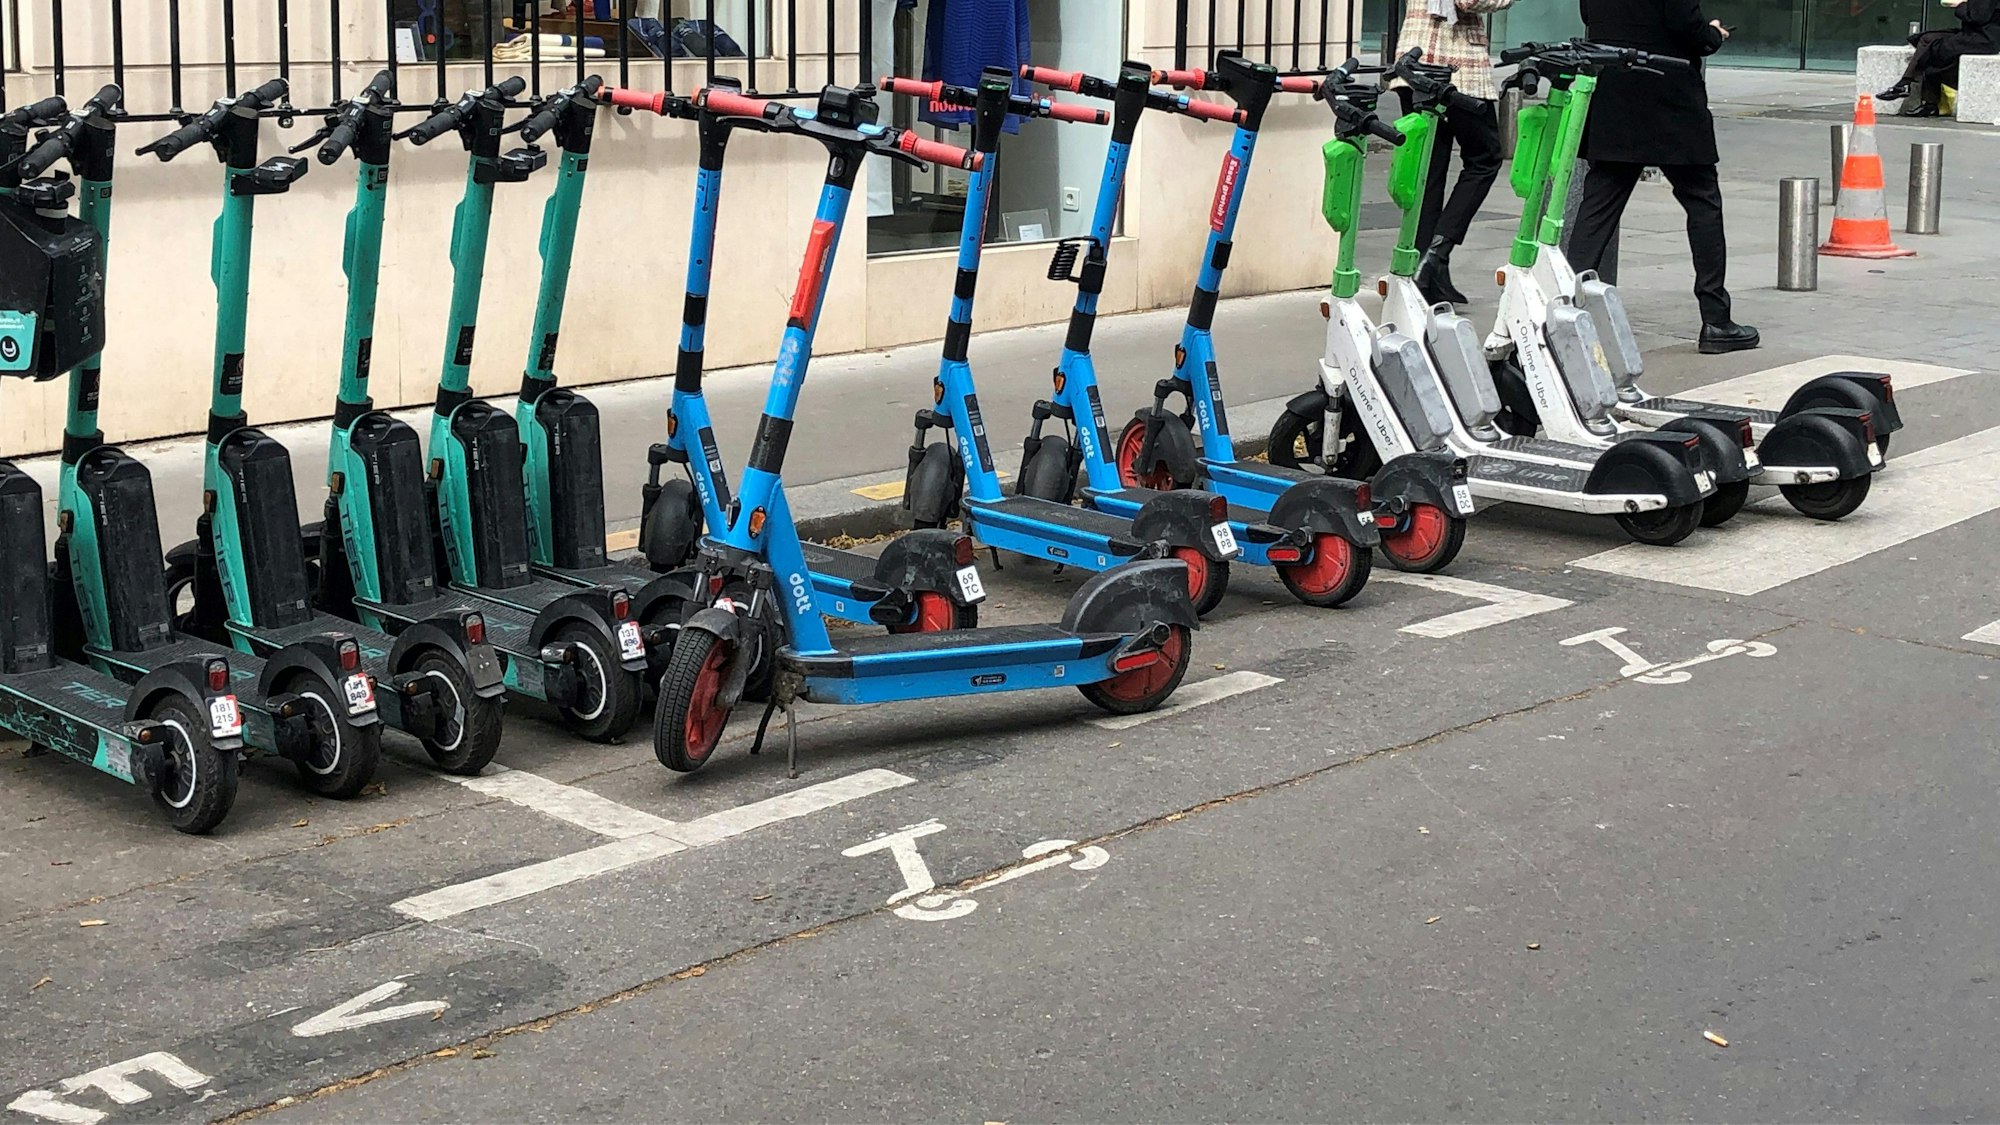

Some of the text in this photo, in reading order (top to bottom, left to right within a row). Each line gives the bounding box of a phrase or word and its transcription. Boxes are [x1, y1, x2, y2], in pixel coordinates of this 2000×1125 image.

[1217, 159, 1238, 217] Essai gratuit
[1520, 326, 1529, 344] On
[1524, 343, 1536, 372] Lime
[1349, 367, 1359, 385] On
[1356, 384, 1373, 411] Lime
[1376, 419, 1394, 446] Uber
[1535, 381, 1549, 409] Uber
[1198, 400, 1211, 431] dott
[472, 436, 480, 471] TIER
[960, 436, 973, 469] dott
[1081, 426, 1095, 459] dott
[371, 451, 381, 485] TIER
[238, 468, 248, 503] TIER
[695, 471, 710, 506] dott
[341, 503, 363, 583] TIER
[440, 493, 459, 569] TIER
[1216, 528, 1229, 539] 98
[214, 523, 236, 605] TIER
[962, 572, 974, 585] 69
[72, 549, 95, 630] TIER
[789, 572, 812, 615] dott
[964, 583, 979, 596] TC
[60, 681, 128, 709] TIER
[214, 702, 232, 714] 181
[215, 713, 234, 725] 215
